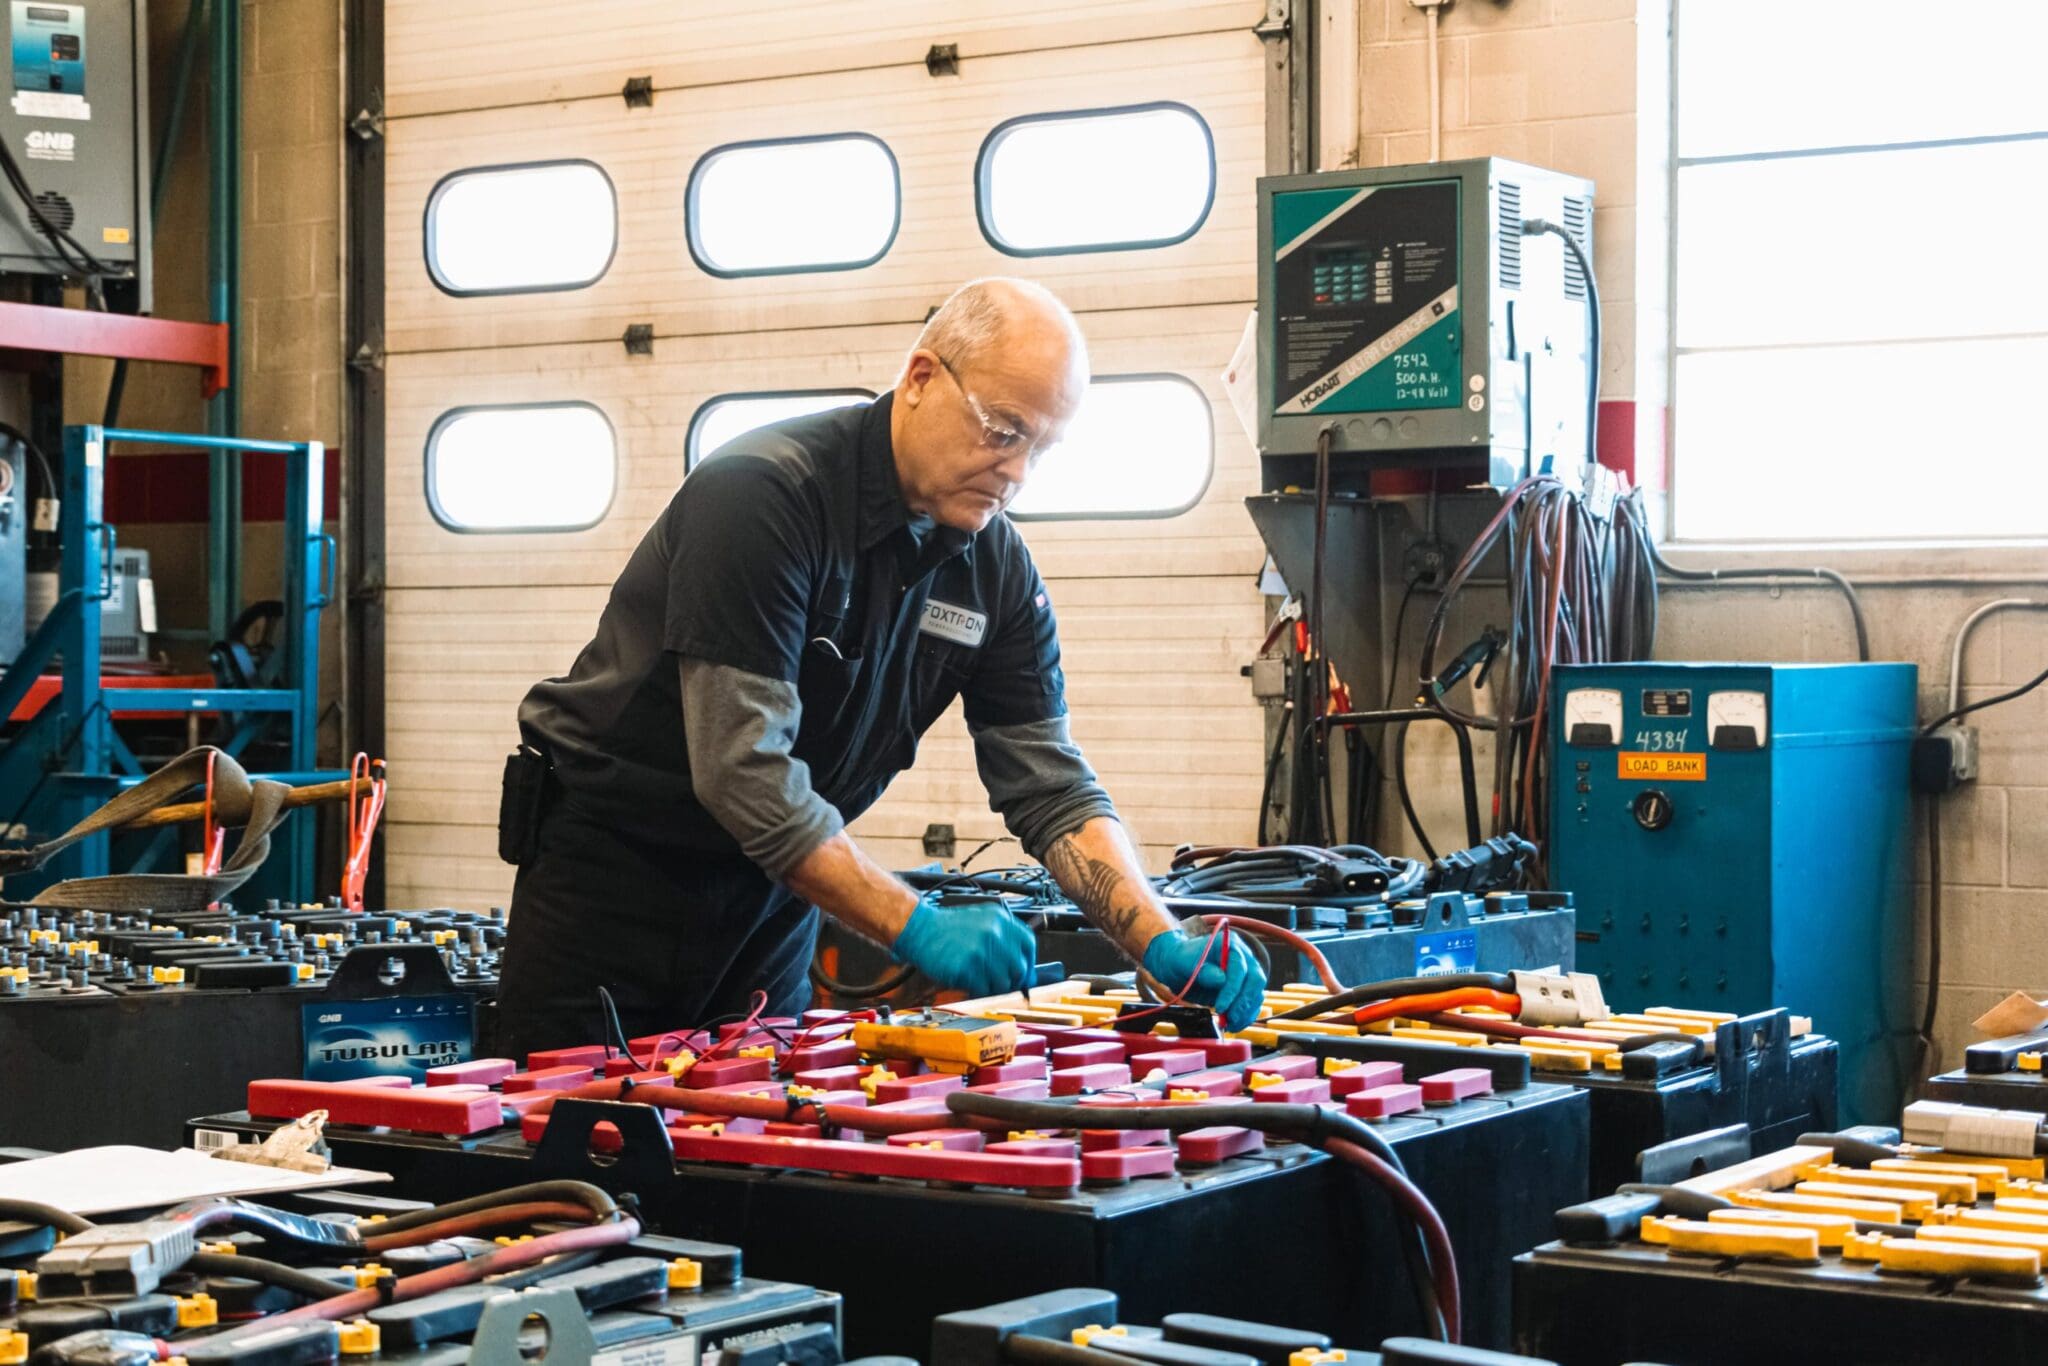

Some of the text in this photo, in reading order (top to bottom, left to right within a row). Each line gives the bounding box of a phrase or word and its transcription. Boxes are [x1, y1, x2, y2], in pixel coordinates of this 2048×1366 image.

[25, 131, 75, 151] GNB
[1393, 352, 1429, 368] 7542
[1299, 372, 1341, 408] HOBART
[1428, 385, 1449, 398] Volt
[923, 603, 984, 633] FOXTRON
[1635, 728, 1688, 752] 4384
[1625, 758, 1699, 772] LOAD BANK
[318, 1014, 342, 1023] GNB
[320, 1041, 460, 1063] TUBULAR
[429, 1055, 460, 1066] LMX
